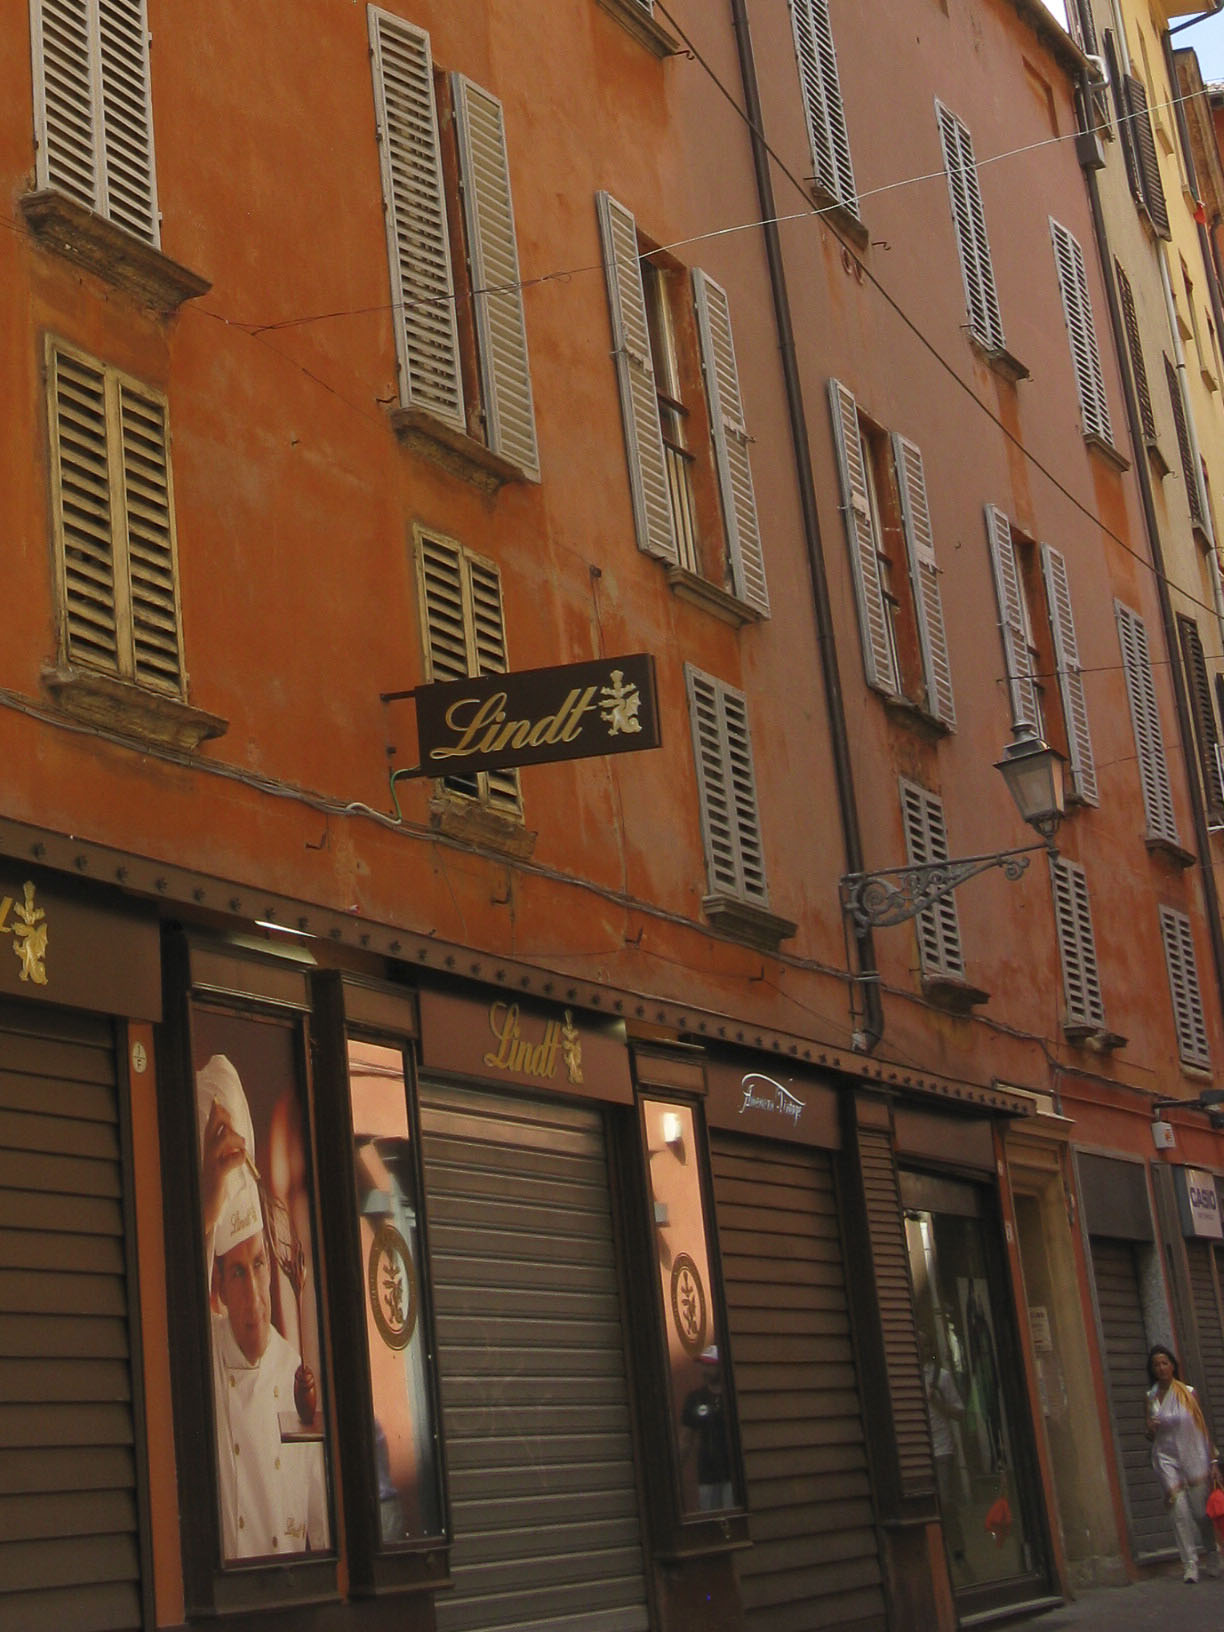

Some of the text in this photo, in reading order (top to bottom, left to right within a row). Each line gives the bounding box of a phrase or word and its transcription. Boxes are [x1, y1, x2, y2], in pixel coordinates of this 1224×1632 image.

[429, 686, 598, 760] Lindt
[483, 1001, 561, 1079] Lindt
[1190, 1187, 1216, 1210] CASIO
